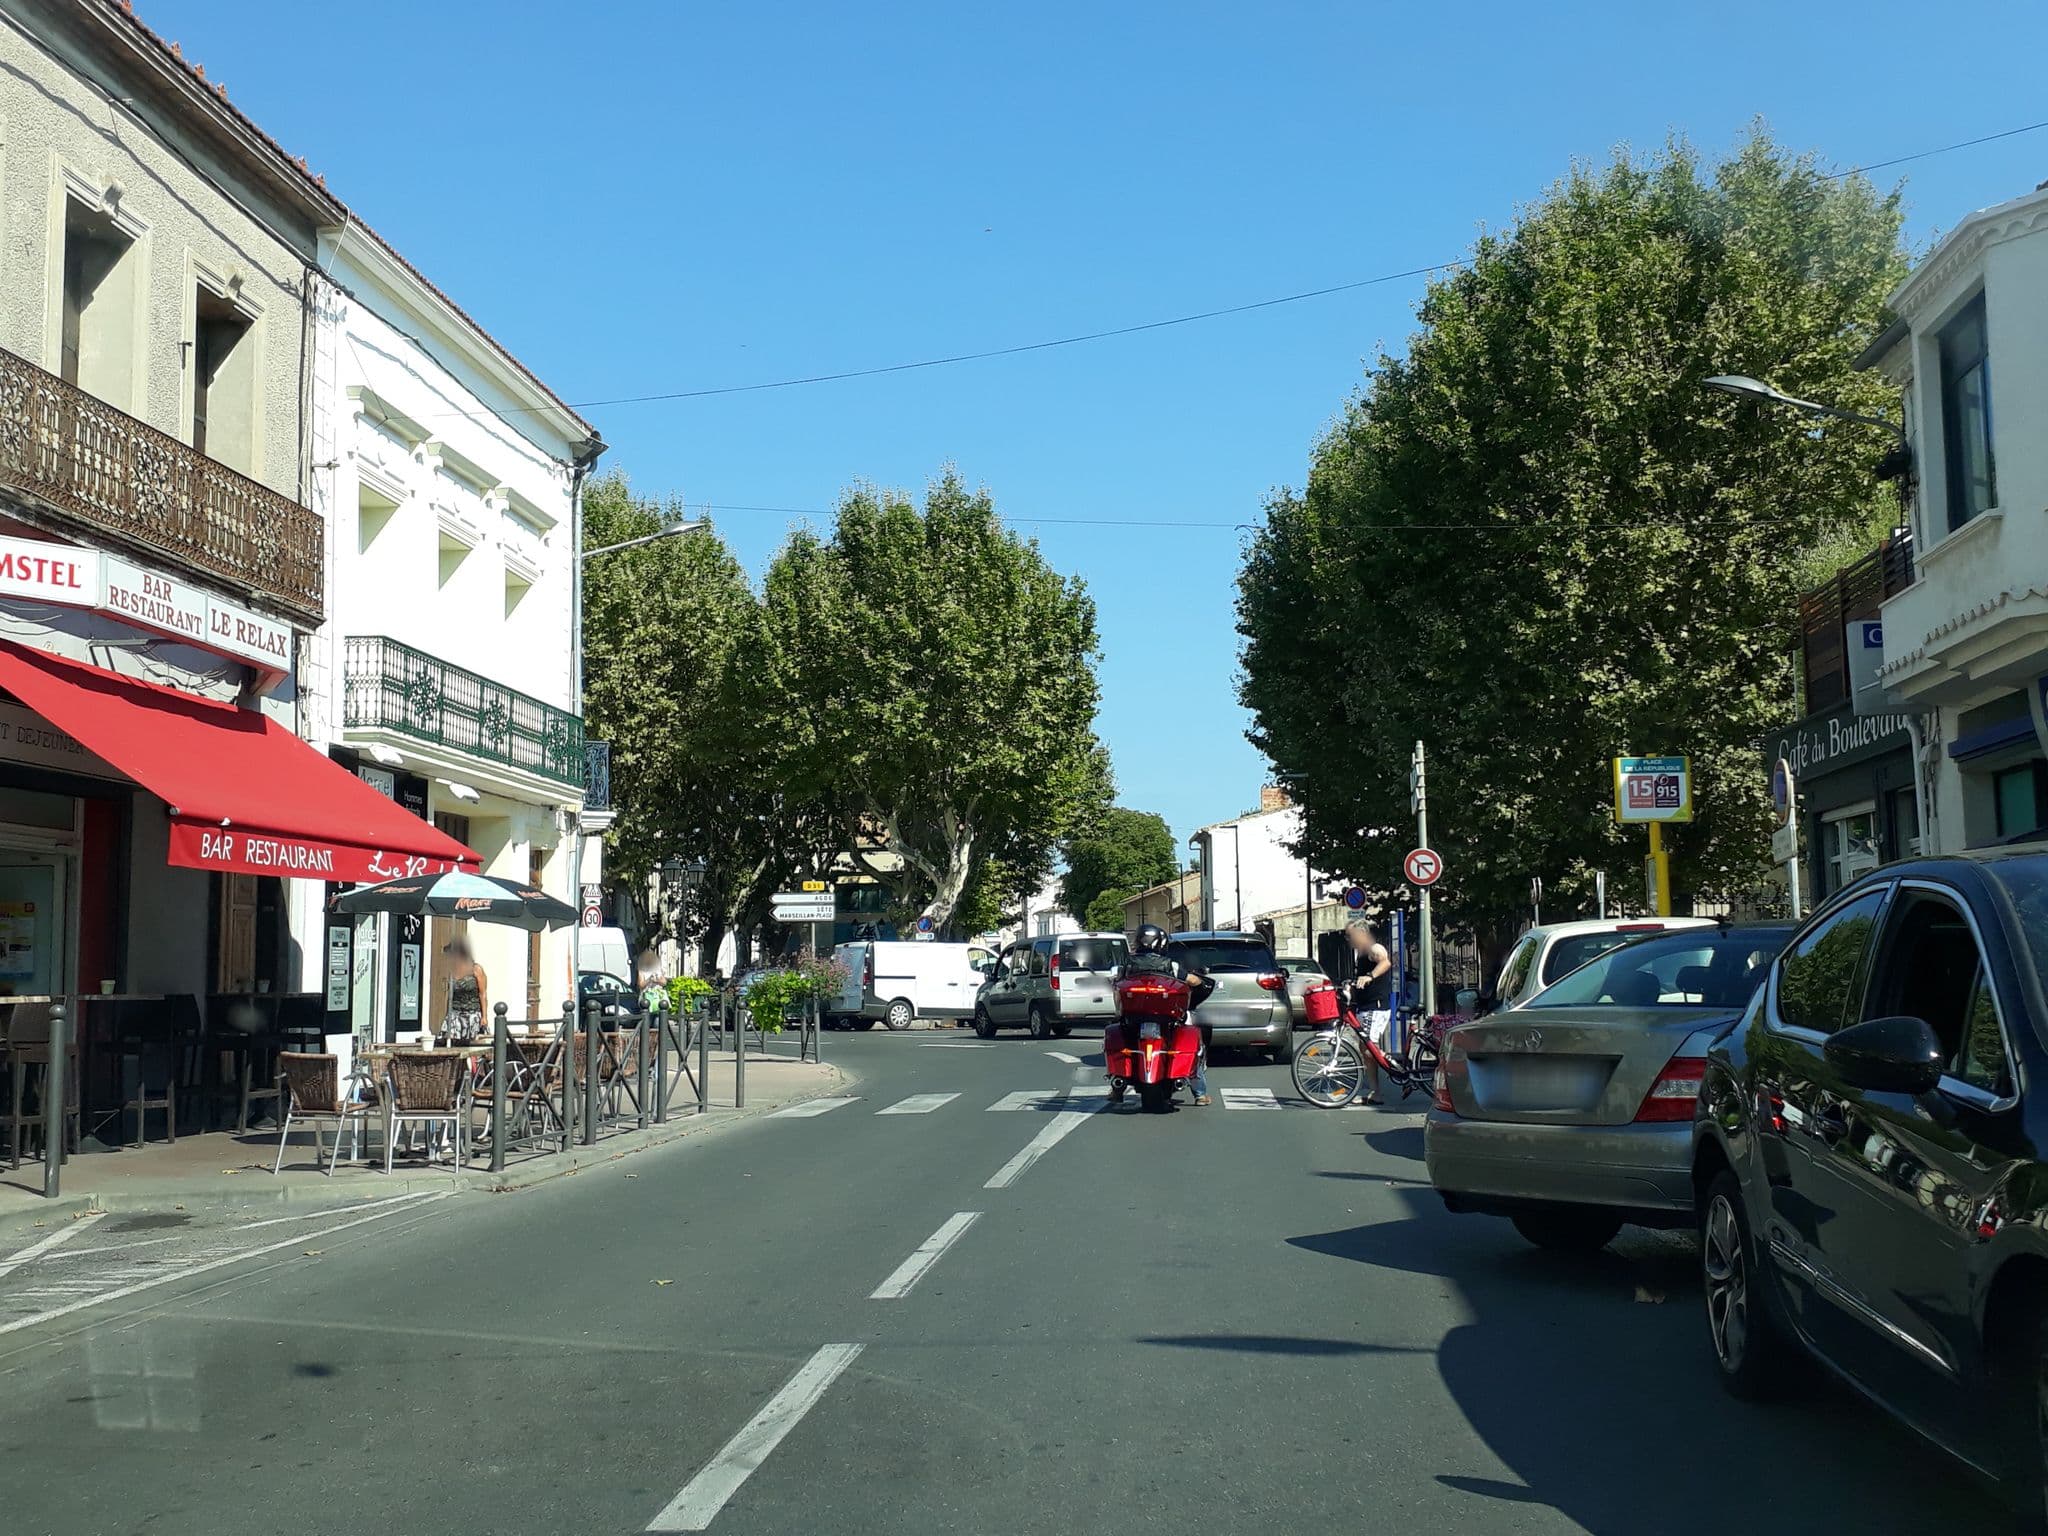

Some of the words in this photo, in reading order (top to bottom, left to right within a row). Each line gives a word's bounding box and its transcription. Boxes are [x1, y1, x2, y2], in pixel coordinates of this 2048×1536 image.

[143, 574, 172, 602] BAR
[109, 585, 202, 634] RESTAURANT
[211, 609, 231, 637] LE
[236, 618, 287, 657] RELAX
[1812, 733, 1825, 763] du
[1630, 780, 1652, 796] 15
[1657, 786, 1677, 797] 915
[201, 833, 233, 861] BAR
[246, 839, 334, 872] RESTAURANT
[368, 850, 402, 877] Le
[588, 914, 599, 925] 30
